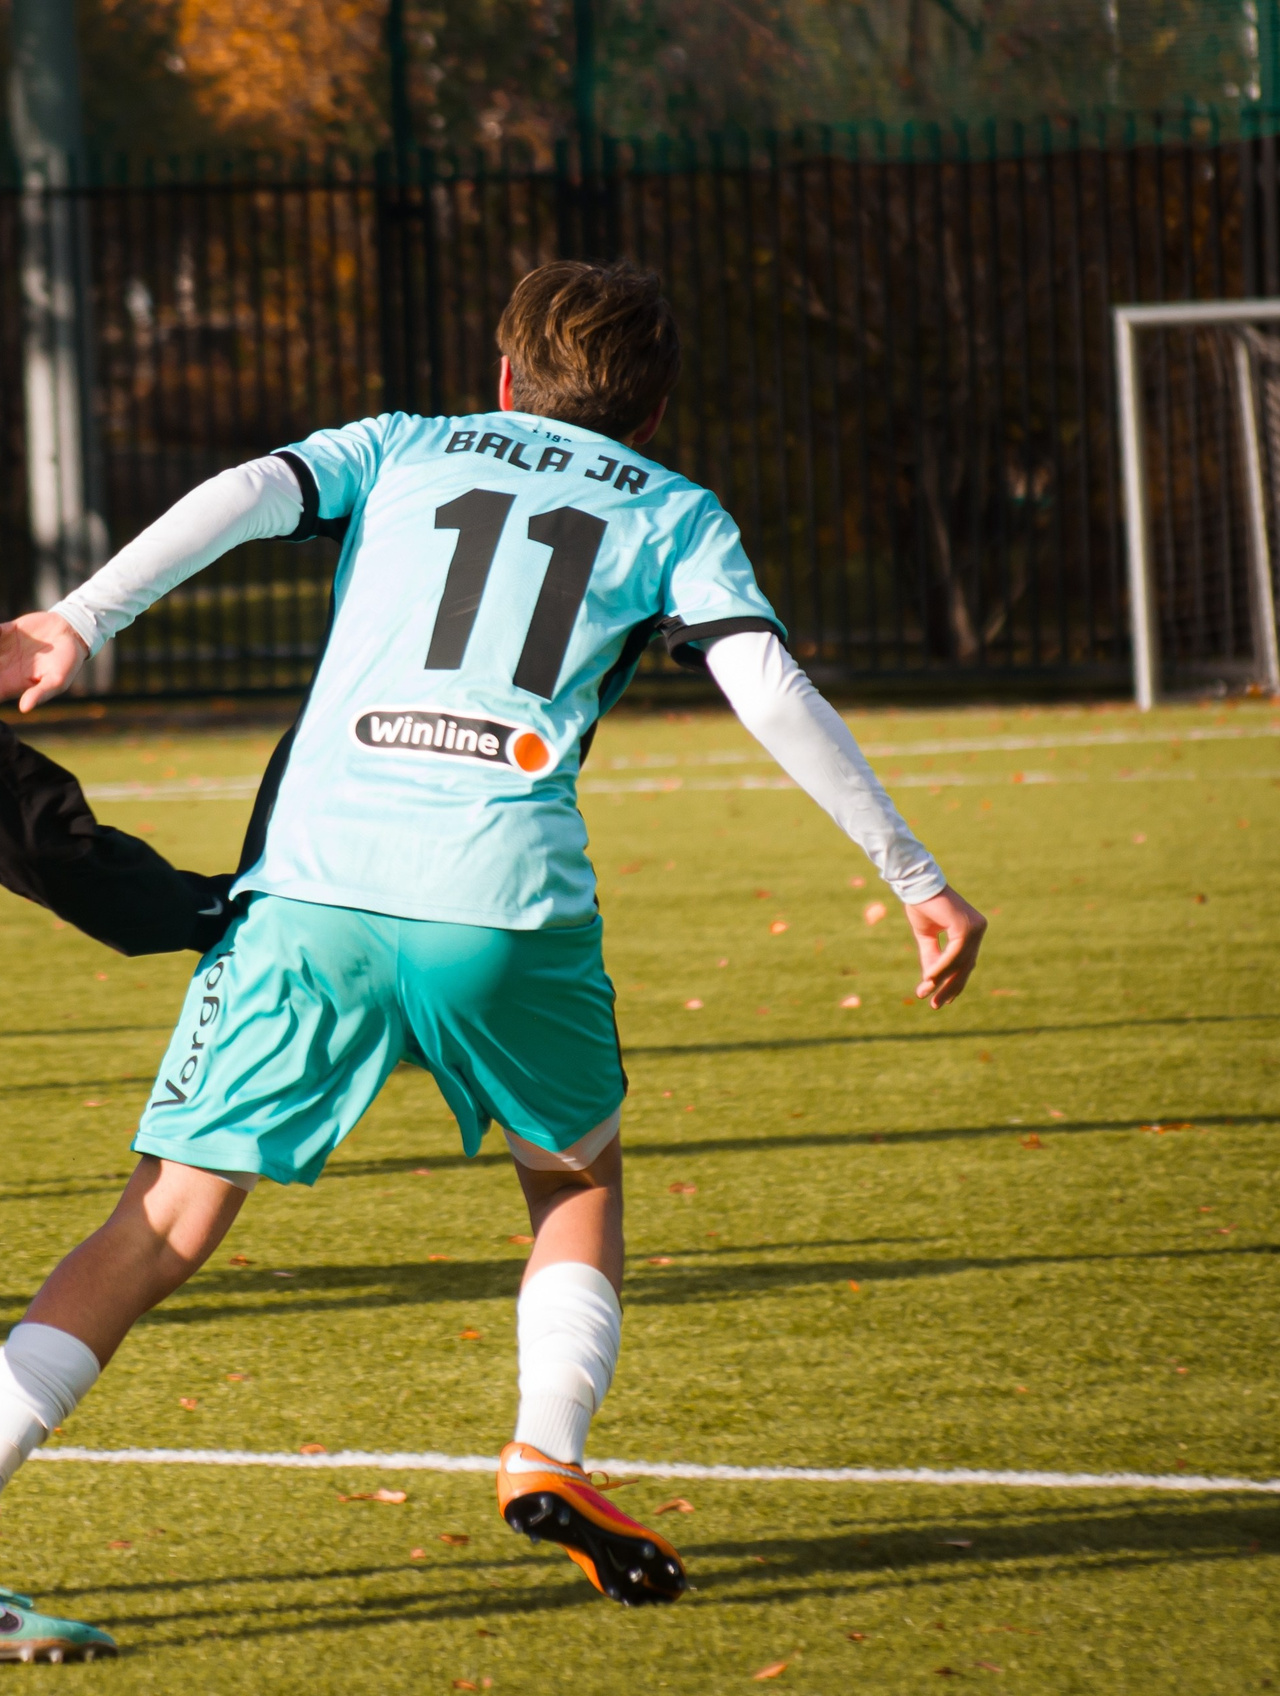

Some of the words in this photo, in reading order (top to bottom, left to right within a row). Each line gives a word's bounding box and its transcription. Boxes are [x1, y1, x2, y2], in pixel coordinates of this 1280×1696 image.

[445, 430, 573, 472] BALA
[584, 455, 650, 495] JR
[424, 488, 609, 701] 11
[370, 716, 500, 755] Winline
